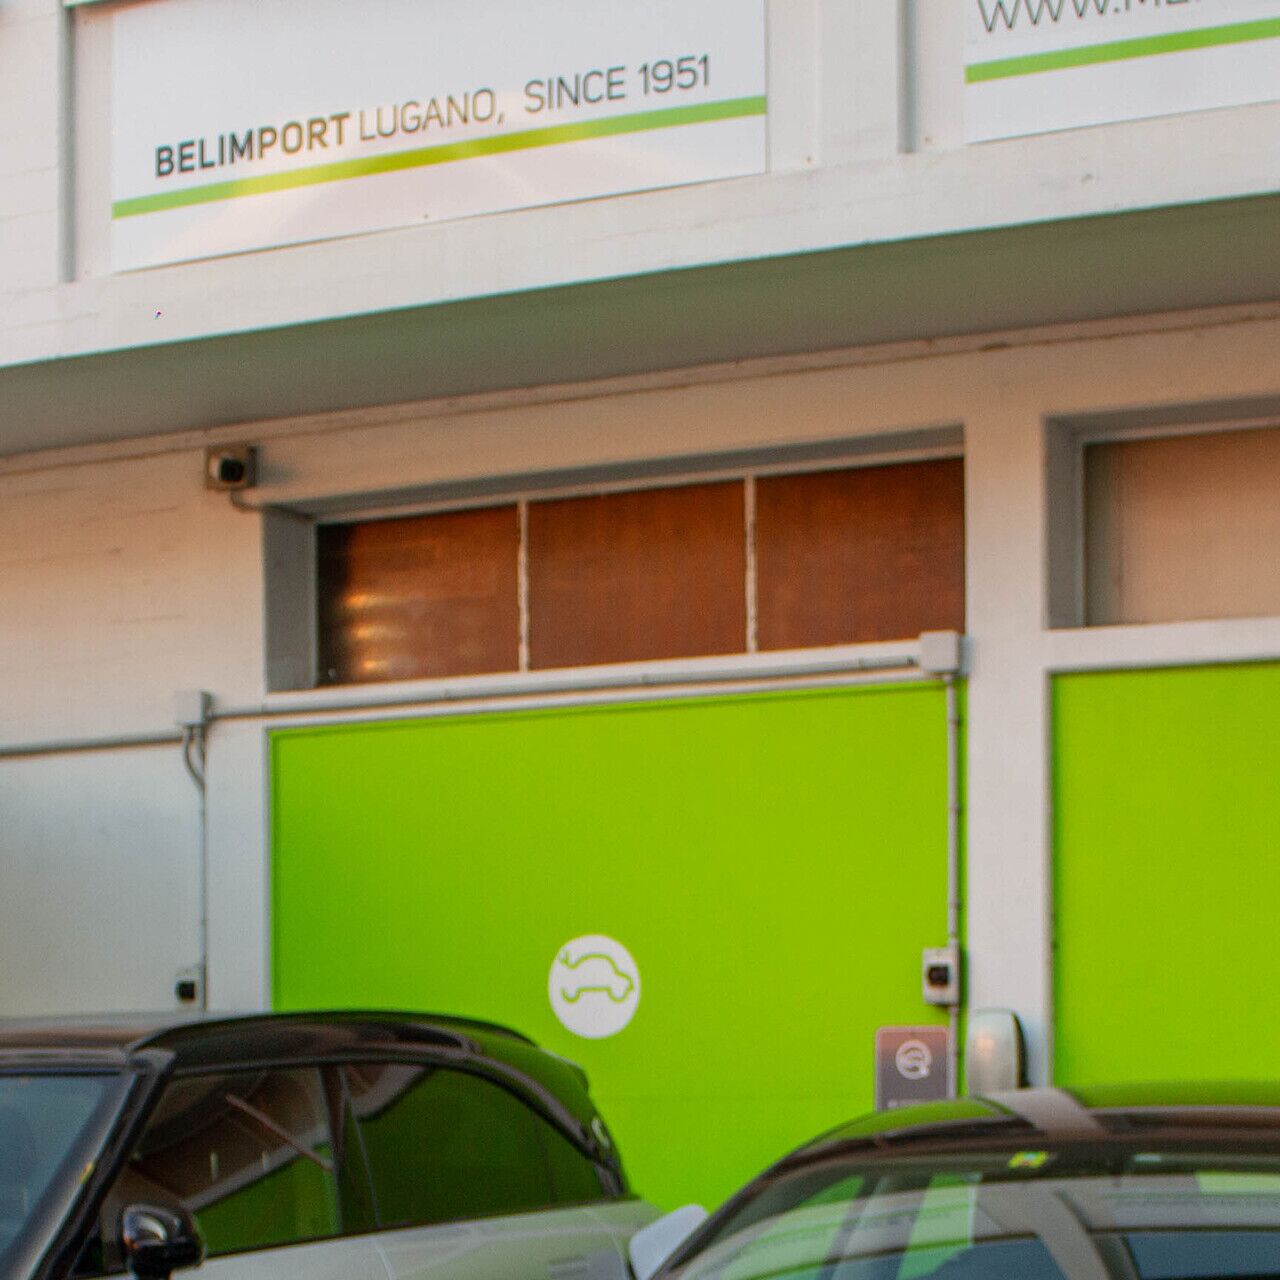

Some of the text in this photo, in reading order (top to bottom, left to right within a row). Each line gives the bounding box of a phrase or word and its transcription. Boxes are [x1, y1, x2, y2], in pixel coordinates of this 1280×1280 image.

[154, 53, 711, 178] BELIMPORT LUGANO, SINCE 1951
